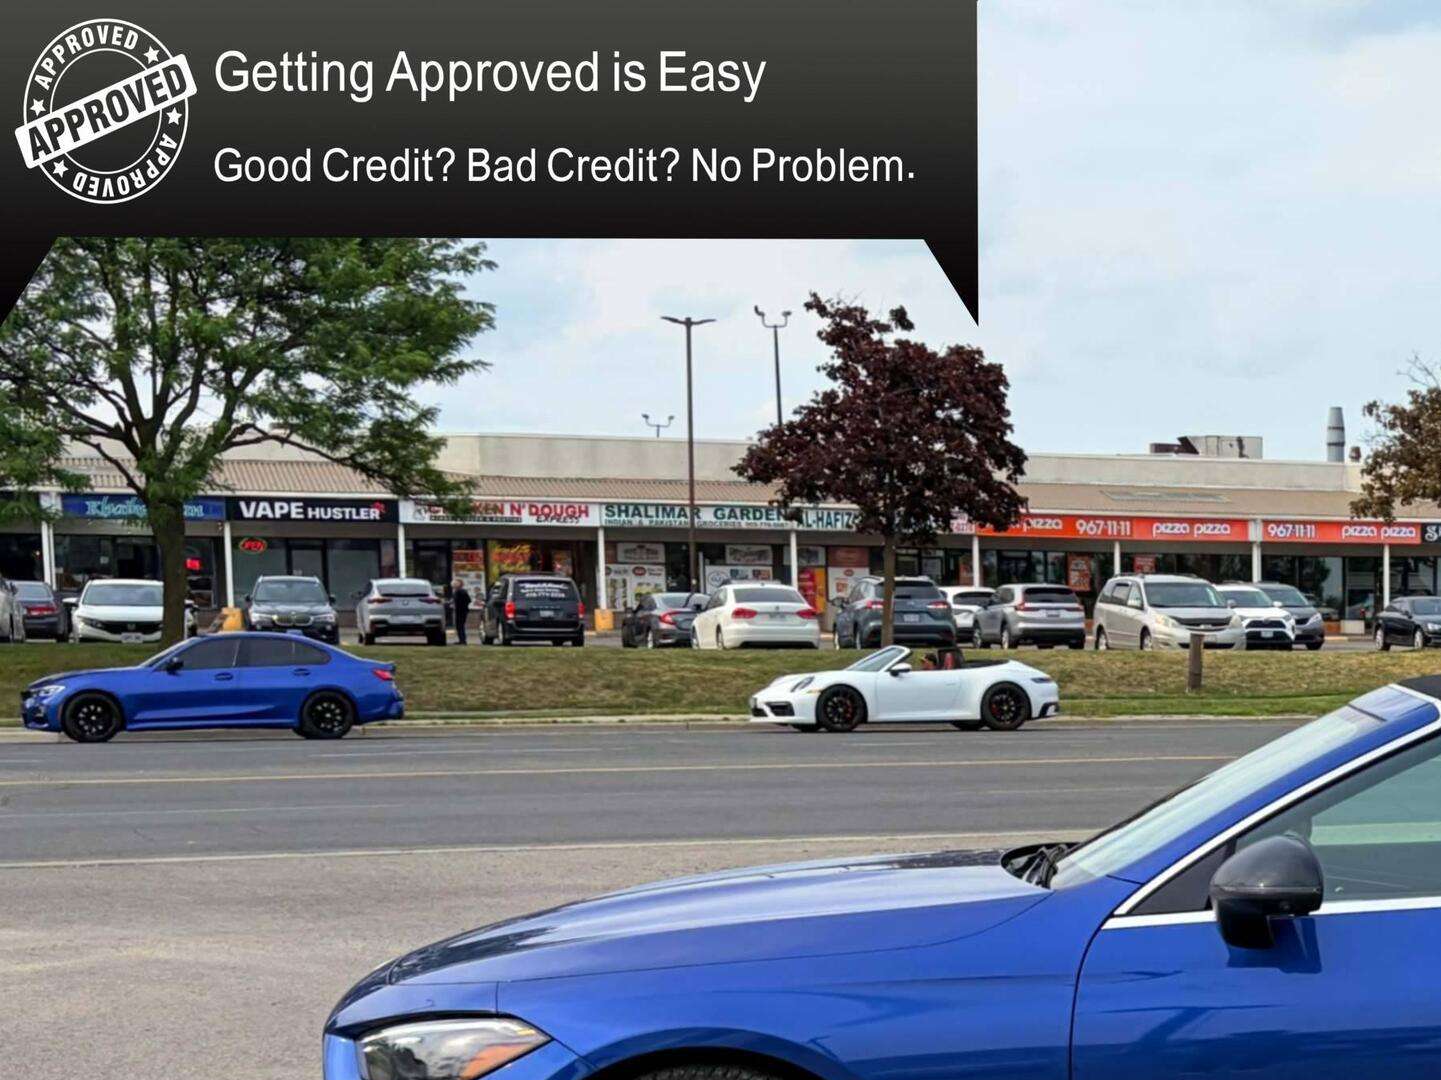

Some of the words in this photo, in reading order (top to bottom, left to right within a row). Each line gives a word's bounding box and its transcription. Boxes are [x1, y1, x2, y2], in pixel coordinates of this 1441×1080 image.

[239, 501, 304, 519] VAPE
[307, 507, 380, 520] HUSTLER
[528, 503, 589, 517] DOUGH
[605, 504, 701, 519] SHALIMAR
[536, 515, 581, 524] EXPRESS
[1022, 518, 1063, 532] pizza
[1152, 522, 1190, 538] pizza
[1193, 523, 1231, 538] pizza
[1341, 525, 1377, 539] pizza
[1380, 526, 1416, 540] pizza
